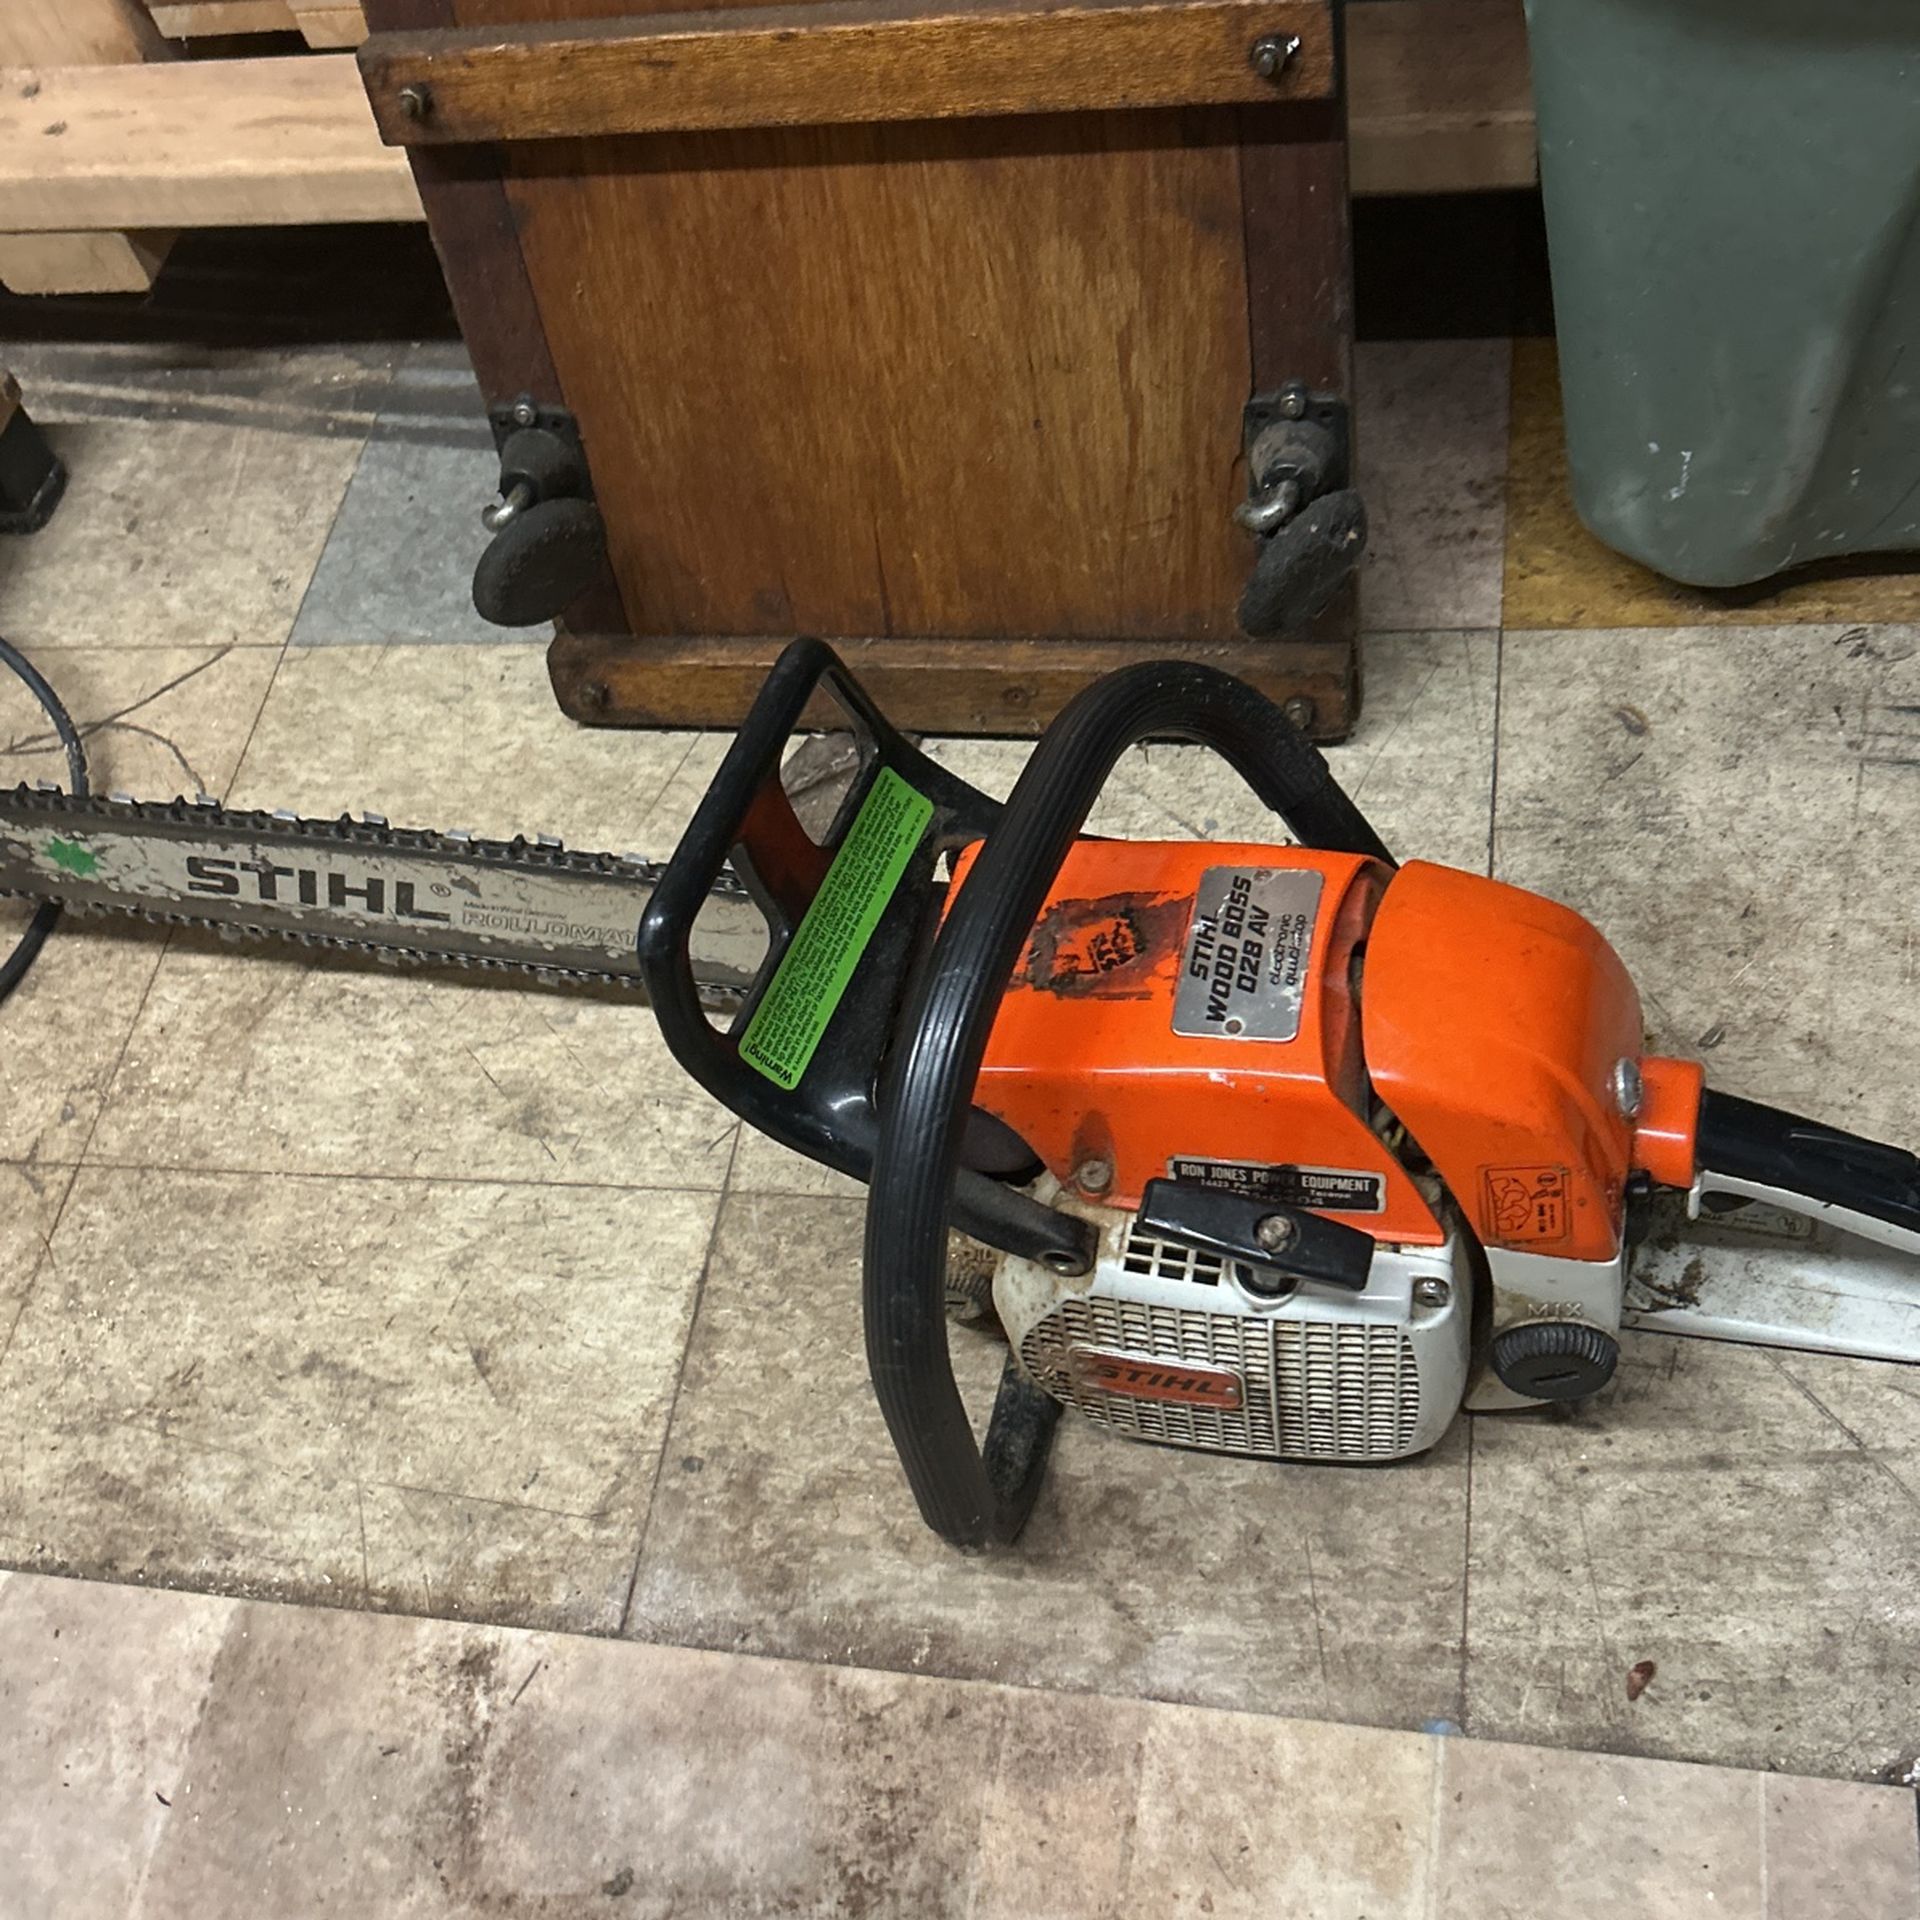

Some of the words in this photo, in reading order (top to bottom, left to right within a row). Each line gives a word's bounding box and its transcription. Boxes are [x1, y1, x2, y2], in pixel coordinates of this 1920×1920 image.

[187, 856, 450, 922] STIHL
[1247, 905, 1270, 938] AV
[1190, 910, 1219, 981] STIHL
[1206, 944, 1237, 1022] WOOD
[1222, 875, 1251, 939] BOSS
[1236, 939, 1263, 994] 028
[745, 1043, 793, 1085] Warning!
[1181, 1163, 1206, 1177] RON
[1211, 1166, 1246, 1182] JONES
[1301, 1174, 1372, 1193] EQUIPMENT
[1527, 1302, 1584, 1318] MIX
[1095, 1363, 1228, 1396] STIHL
